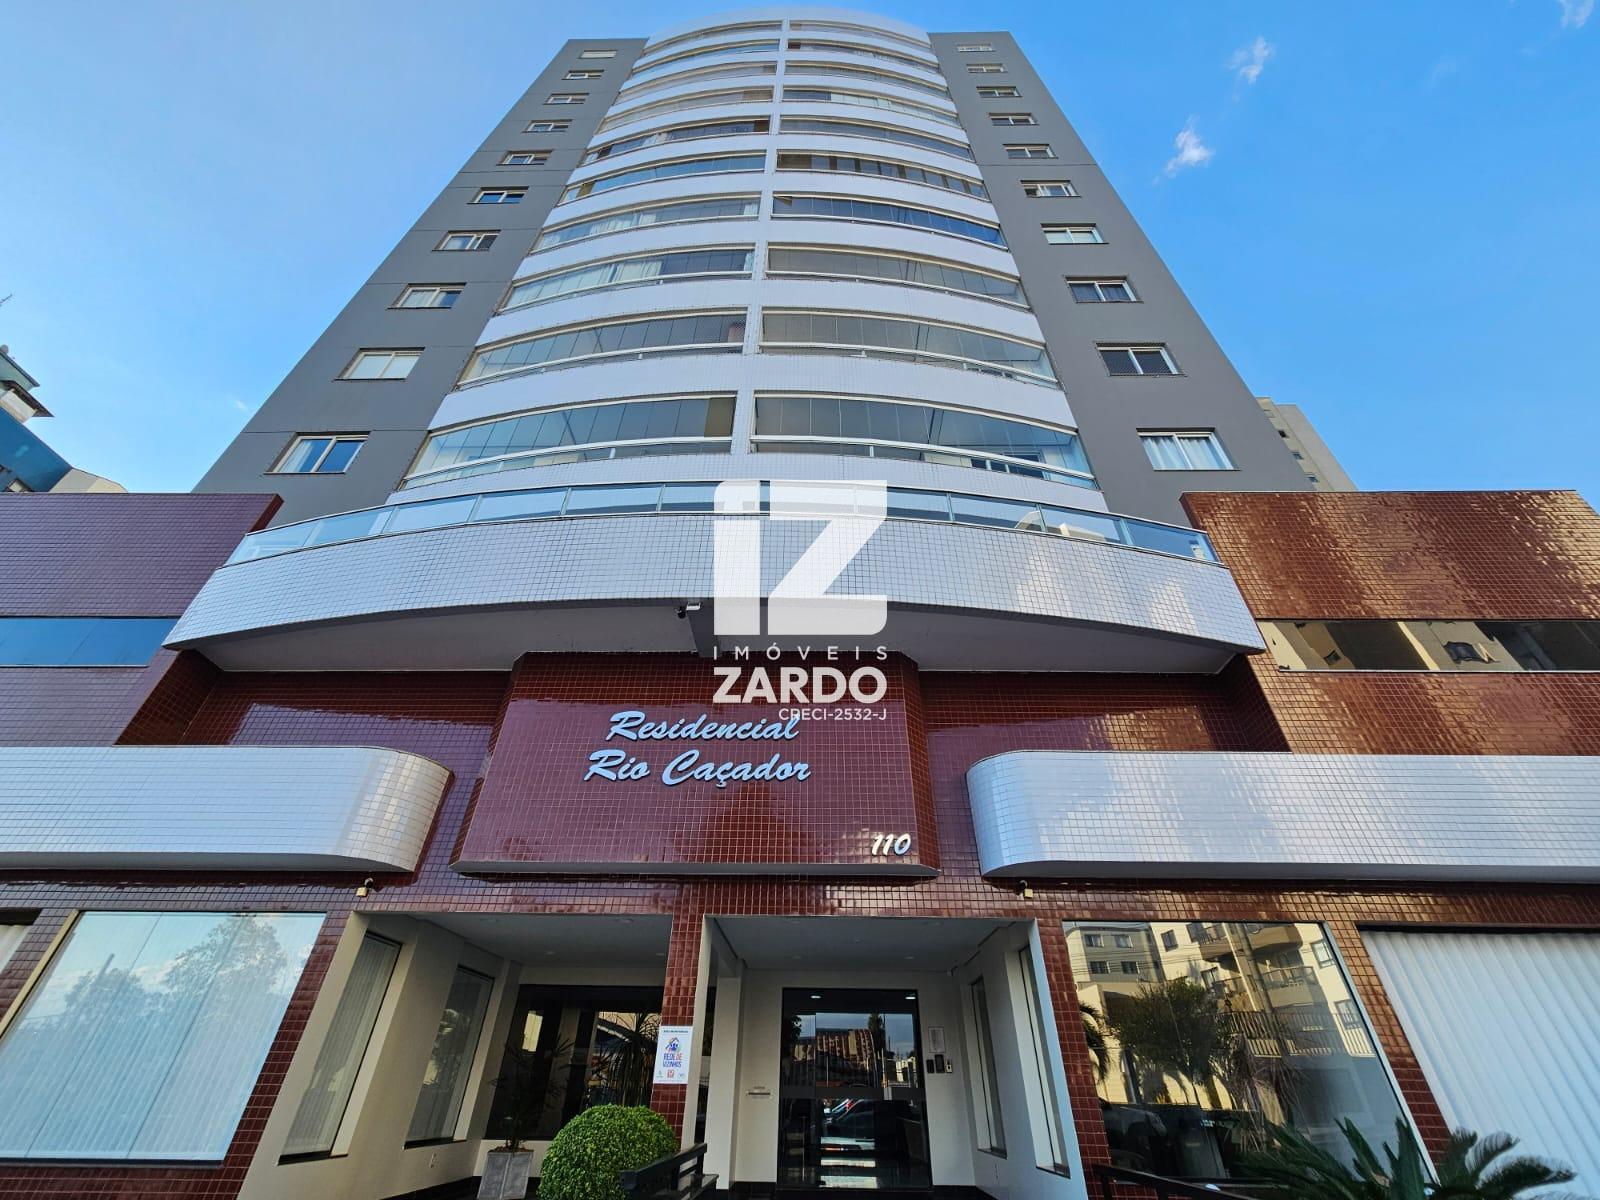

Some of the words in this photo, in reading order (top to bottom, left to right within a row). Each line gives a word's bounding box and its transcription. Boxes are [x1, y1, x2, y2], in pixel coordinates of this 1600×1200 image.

[605, 710, 800, 742] Residencial
[583, 748, 651, 783] Rio
[660, 748, 812, 788] Caçador
[870, 832, 912, 857] 110
